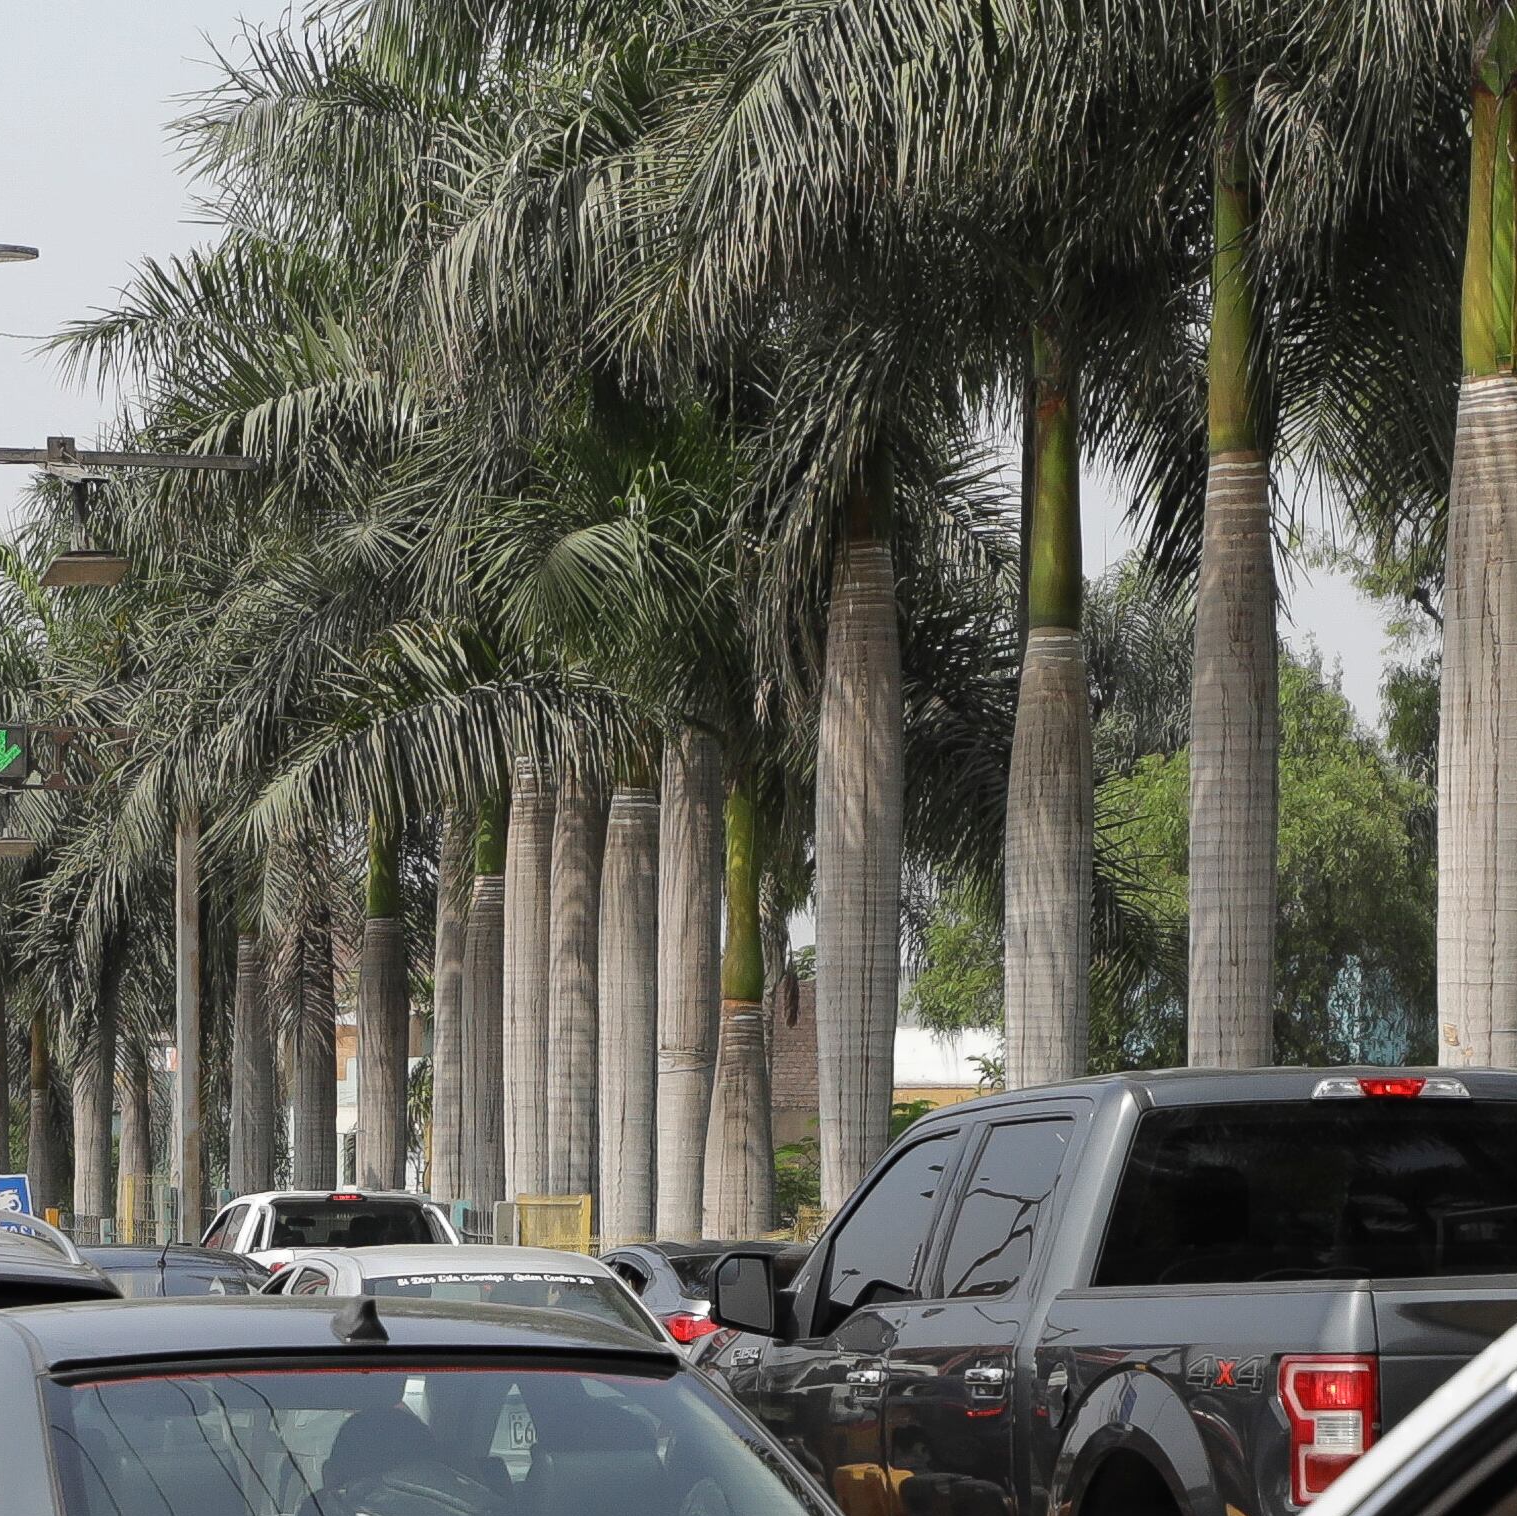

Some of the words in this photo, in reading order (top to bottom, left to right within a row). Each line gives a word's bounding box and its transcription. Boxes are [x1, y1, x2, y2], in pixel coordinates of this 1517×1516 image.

[411, 1276, 436, 1285] Dios
[462, 1273, 505, 1283] Conmigo
[512, 1273, 543, 1283] Quien
[543, 1274, 576, 1283] Contra
